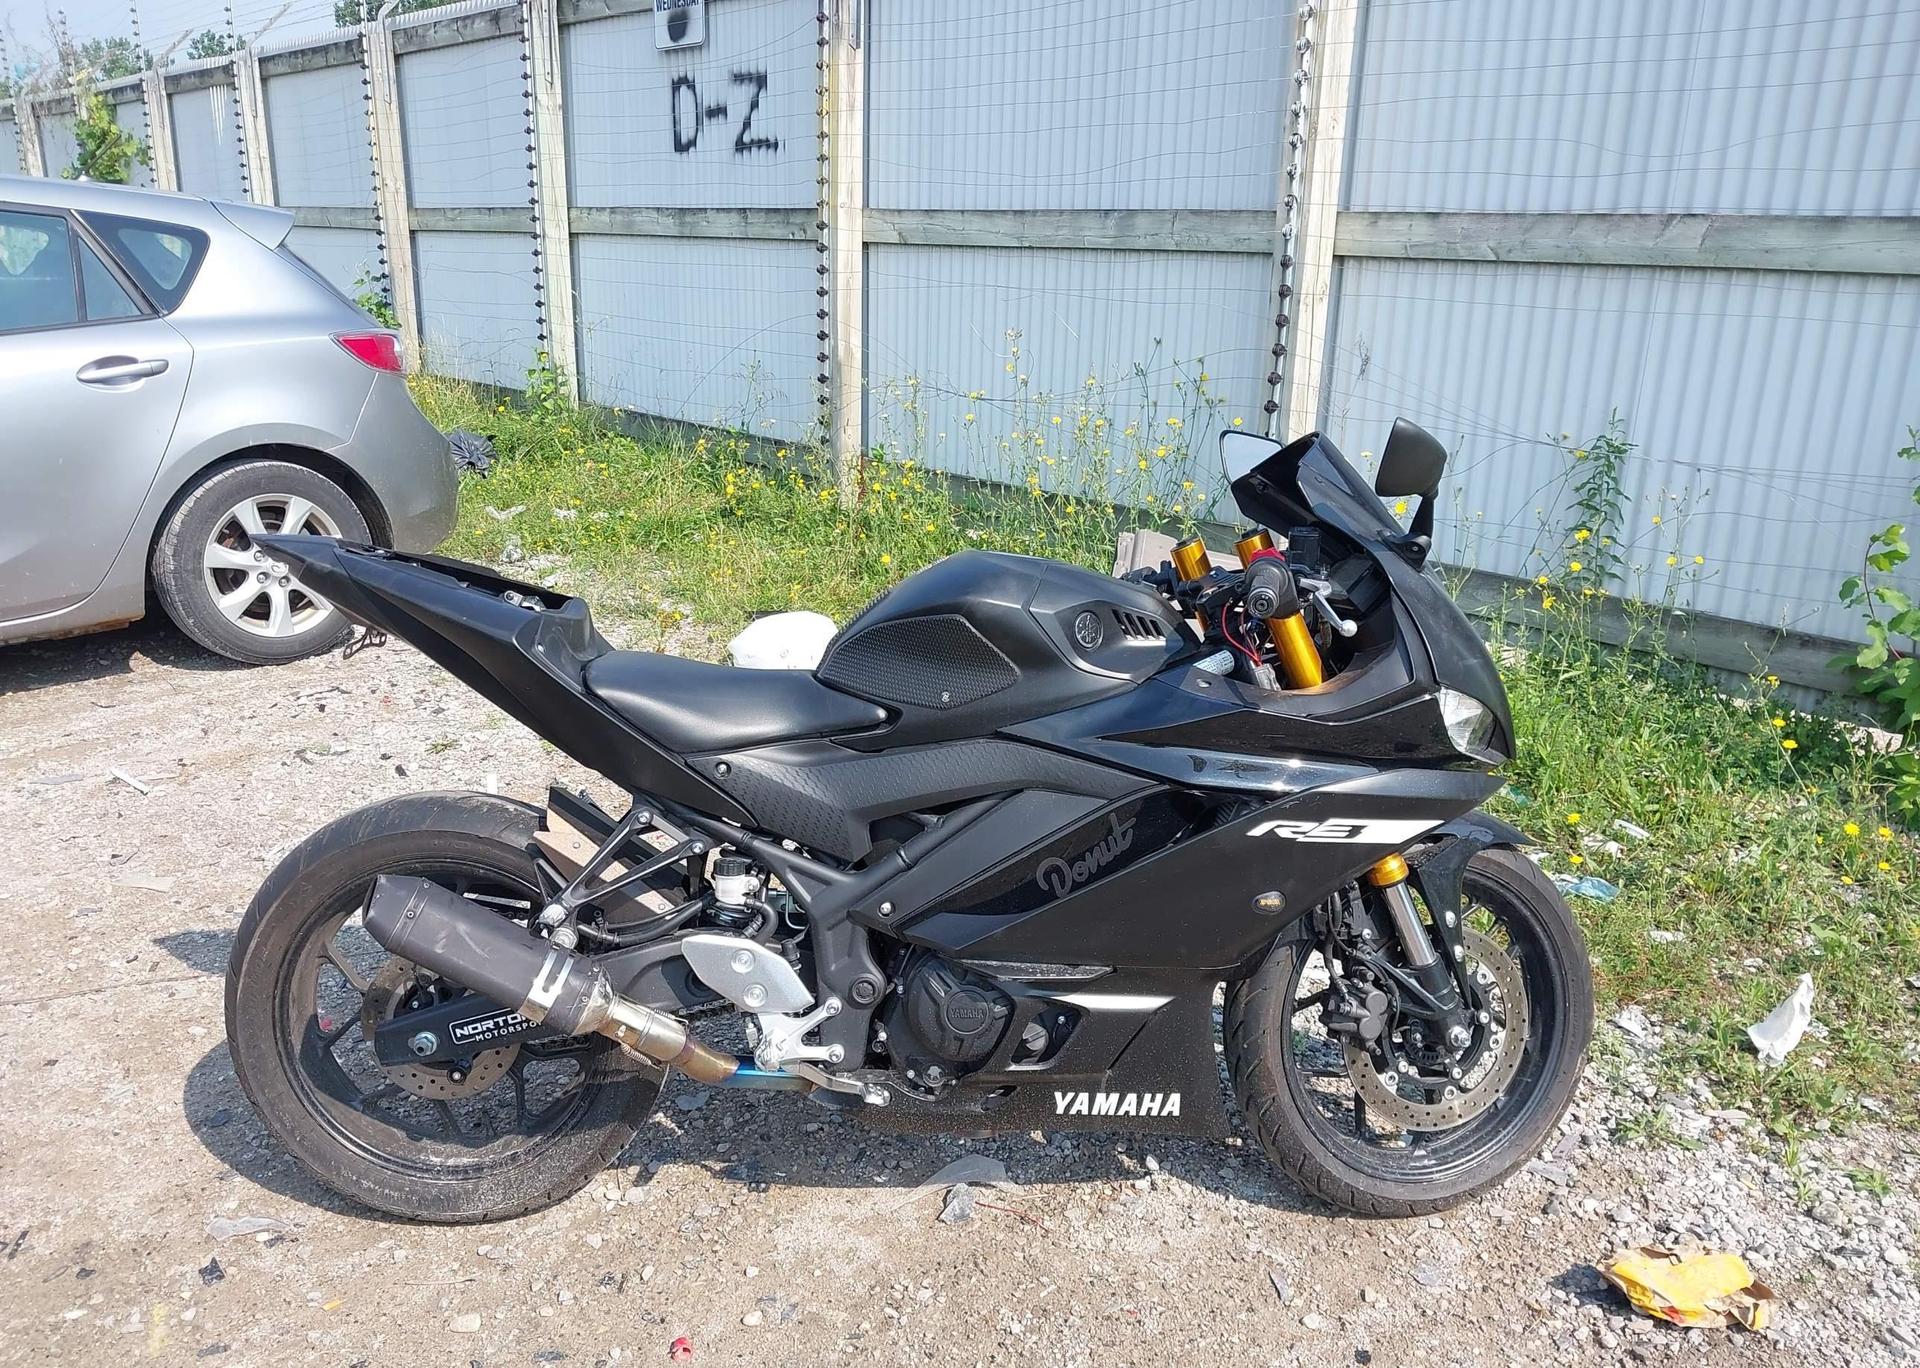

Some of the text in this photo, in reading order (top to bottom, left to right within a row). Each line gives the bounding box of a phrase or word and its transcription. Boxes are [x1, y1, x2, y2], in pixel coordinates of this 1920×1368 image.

[1036, 812, 1137, 898] Donut
[454, 1012, 526, 1038] NORTO
[950, 1008, 984, 1019] YAMAHA
[475, 1020, 542, 1042] MOTORSPO
[1054, 1091, 1181, 1117] YAMAHA
